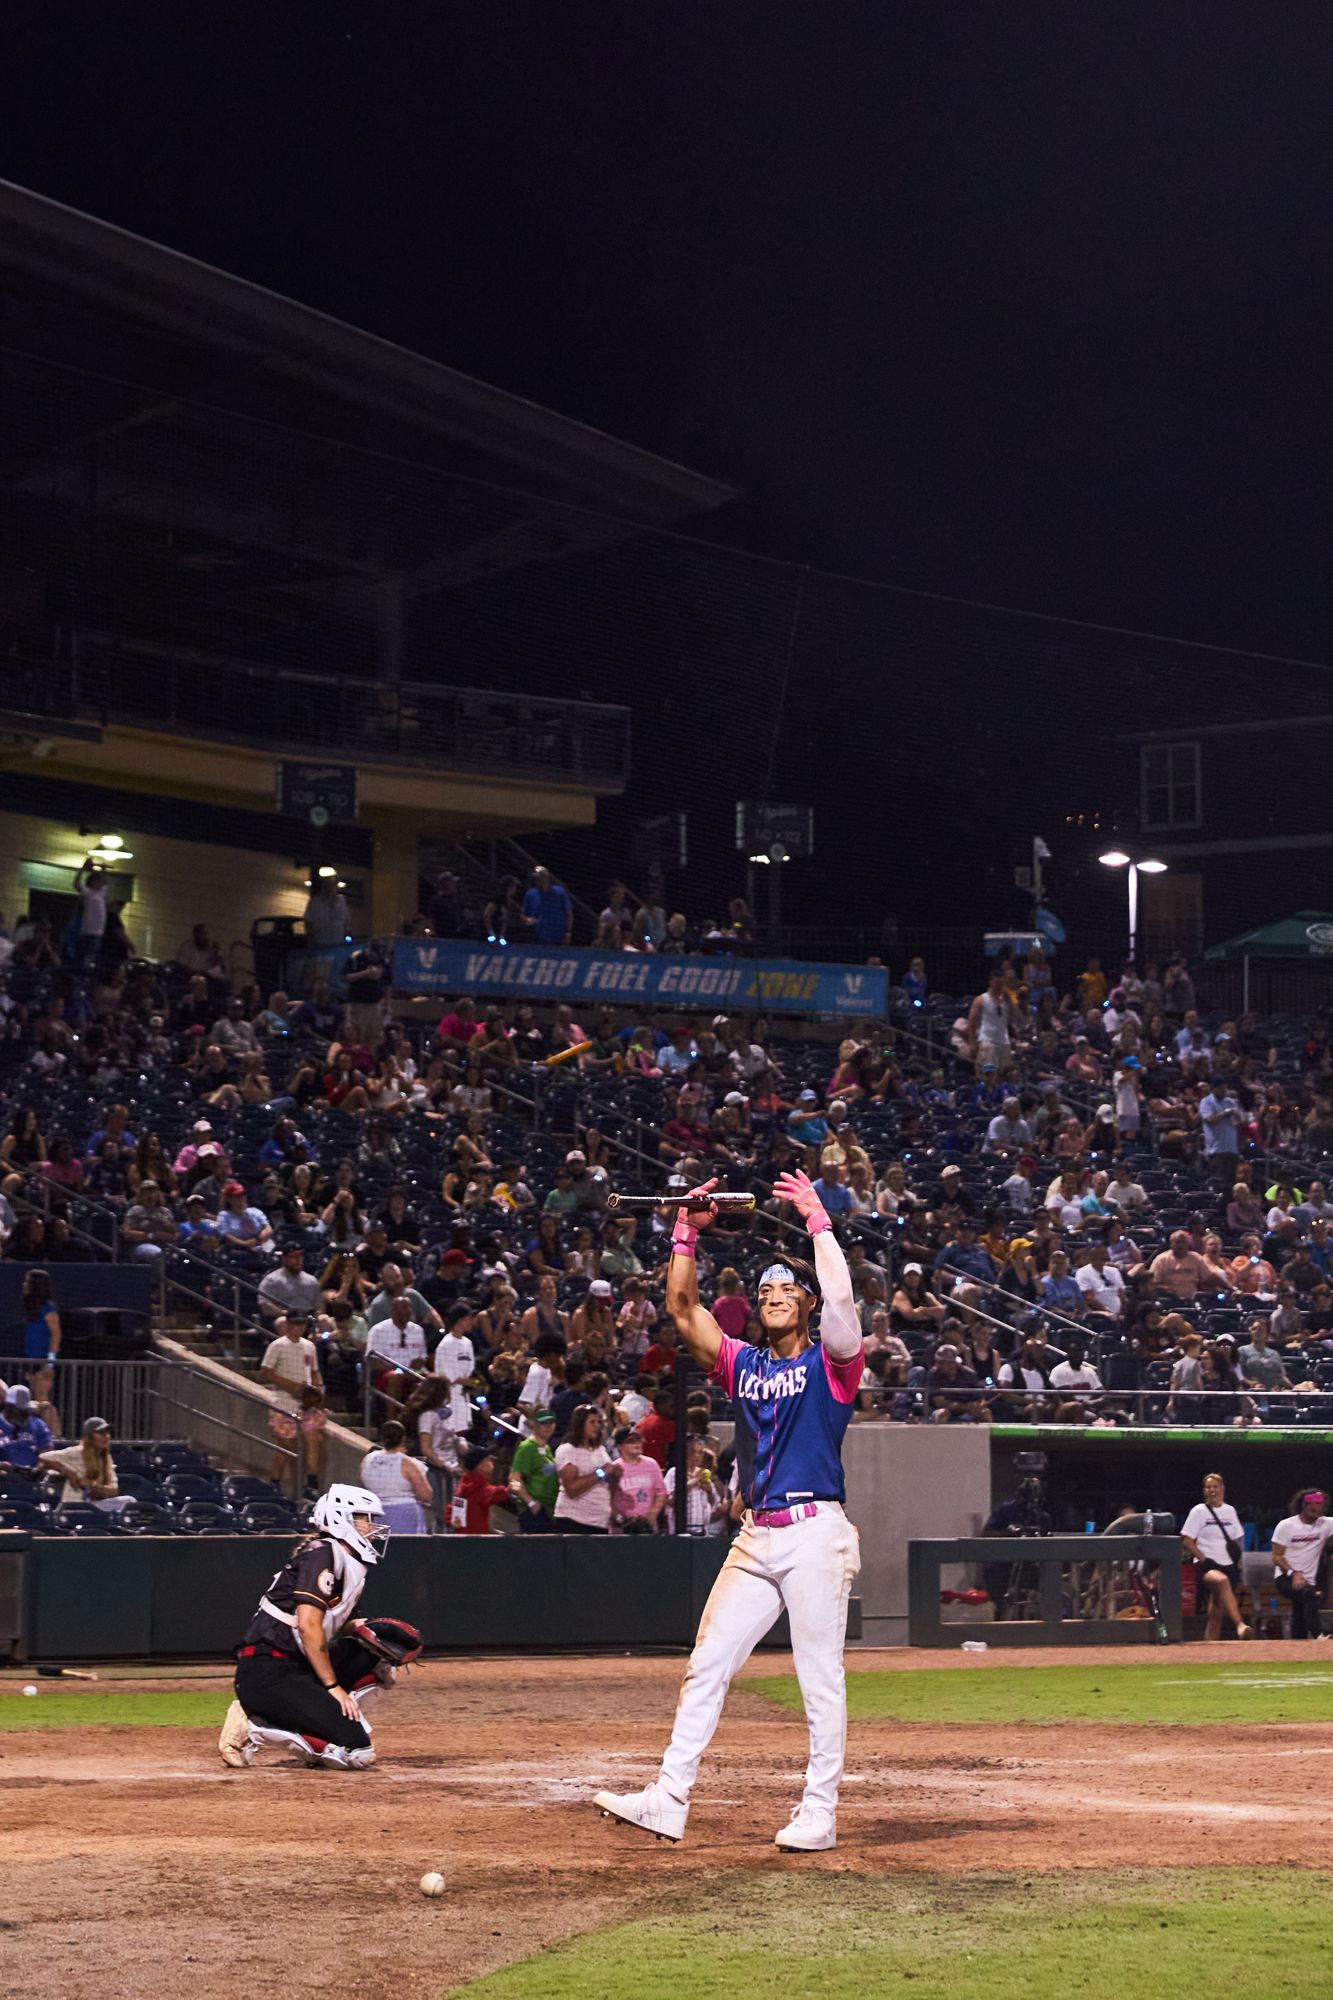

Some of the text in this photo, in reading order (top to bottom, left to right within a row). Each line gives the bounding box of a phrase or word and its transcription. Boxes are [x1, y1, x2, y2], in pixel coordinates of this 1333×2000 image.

[464, 953, 821, 1000] VALERO FUEL GOOD ZONE
